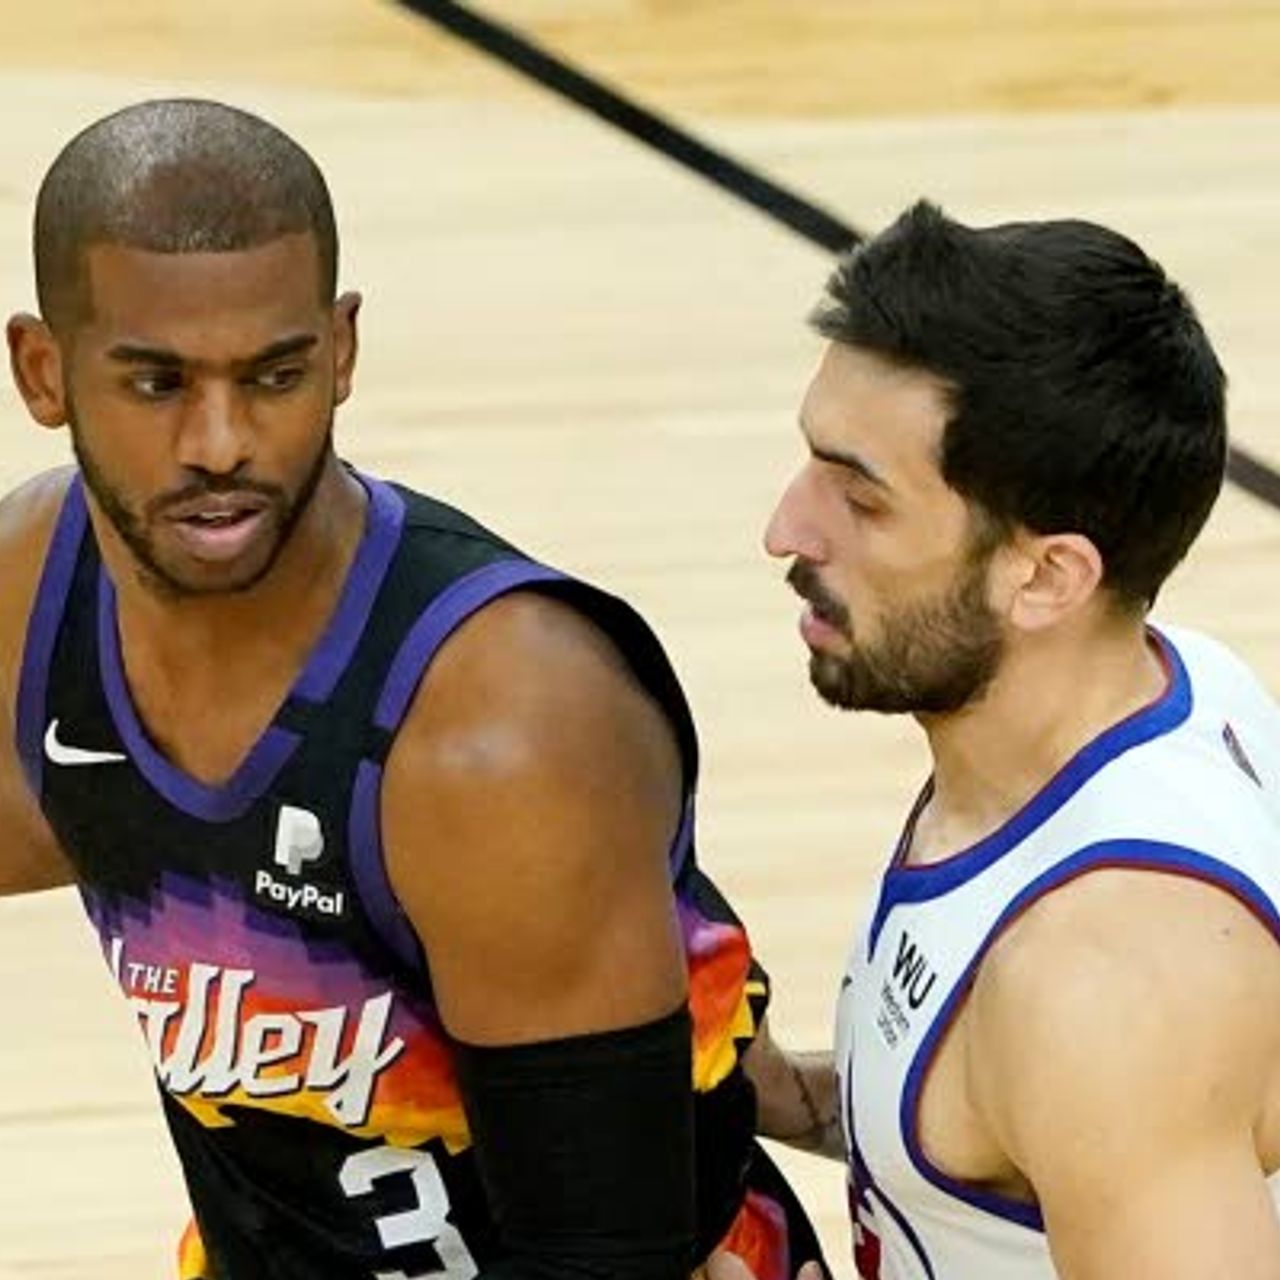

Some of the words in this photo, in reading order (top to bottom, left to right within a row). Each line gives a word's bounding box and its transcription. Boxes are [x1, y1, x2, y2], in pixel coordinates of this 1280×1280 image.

[256, 870, 343, 915] PayPal
[127, 962, 180, 994] THE
[893, 930, 936, 1009] WU
